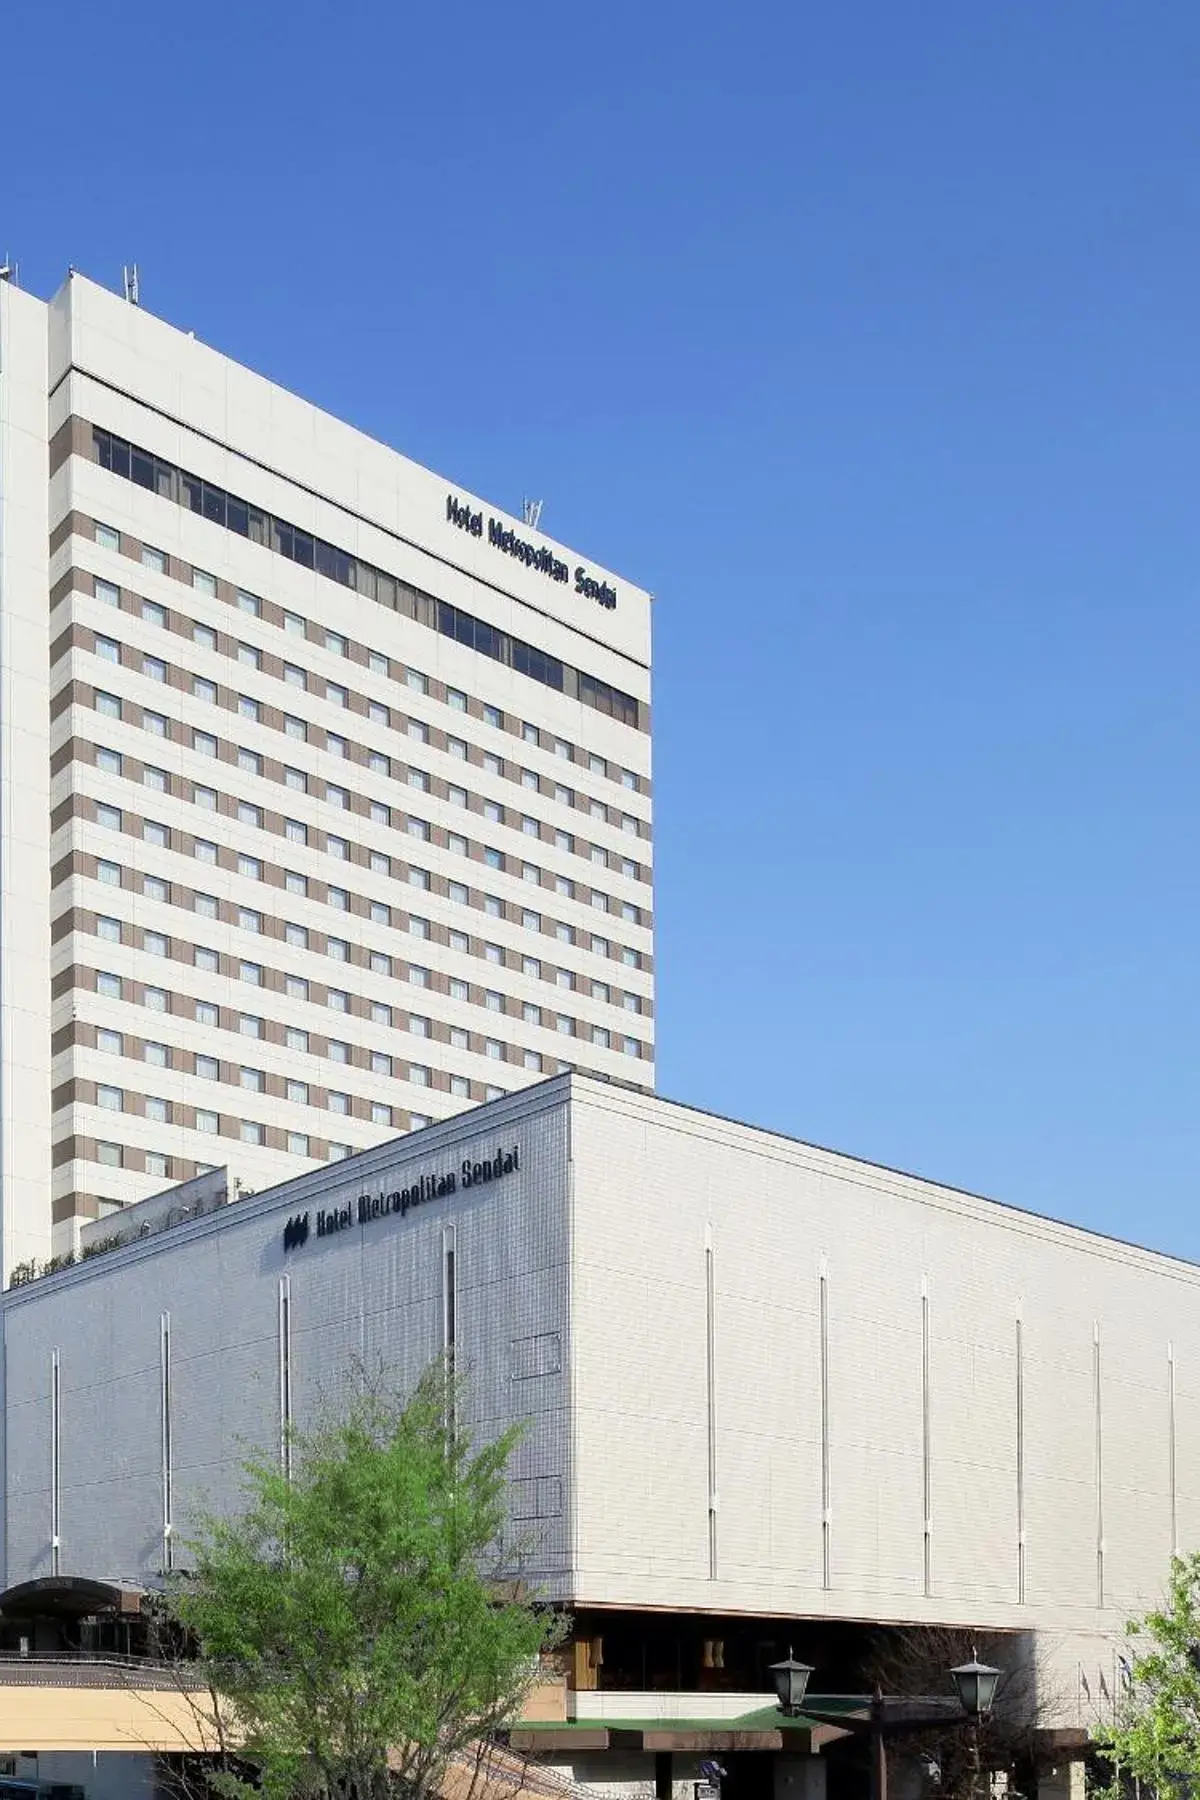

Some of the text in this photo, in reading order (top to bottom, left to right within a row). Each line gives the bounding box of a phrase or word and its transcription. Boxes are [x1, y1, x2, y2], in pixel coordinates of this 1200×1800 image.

[446, 494, 617, 610] Hotel Metropolitan Sendai
[316, 1145, 520, 1238] Hotel Metropolitan Sendai
